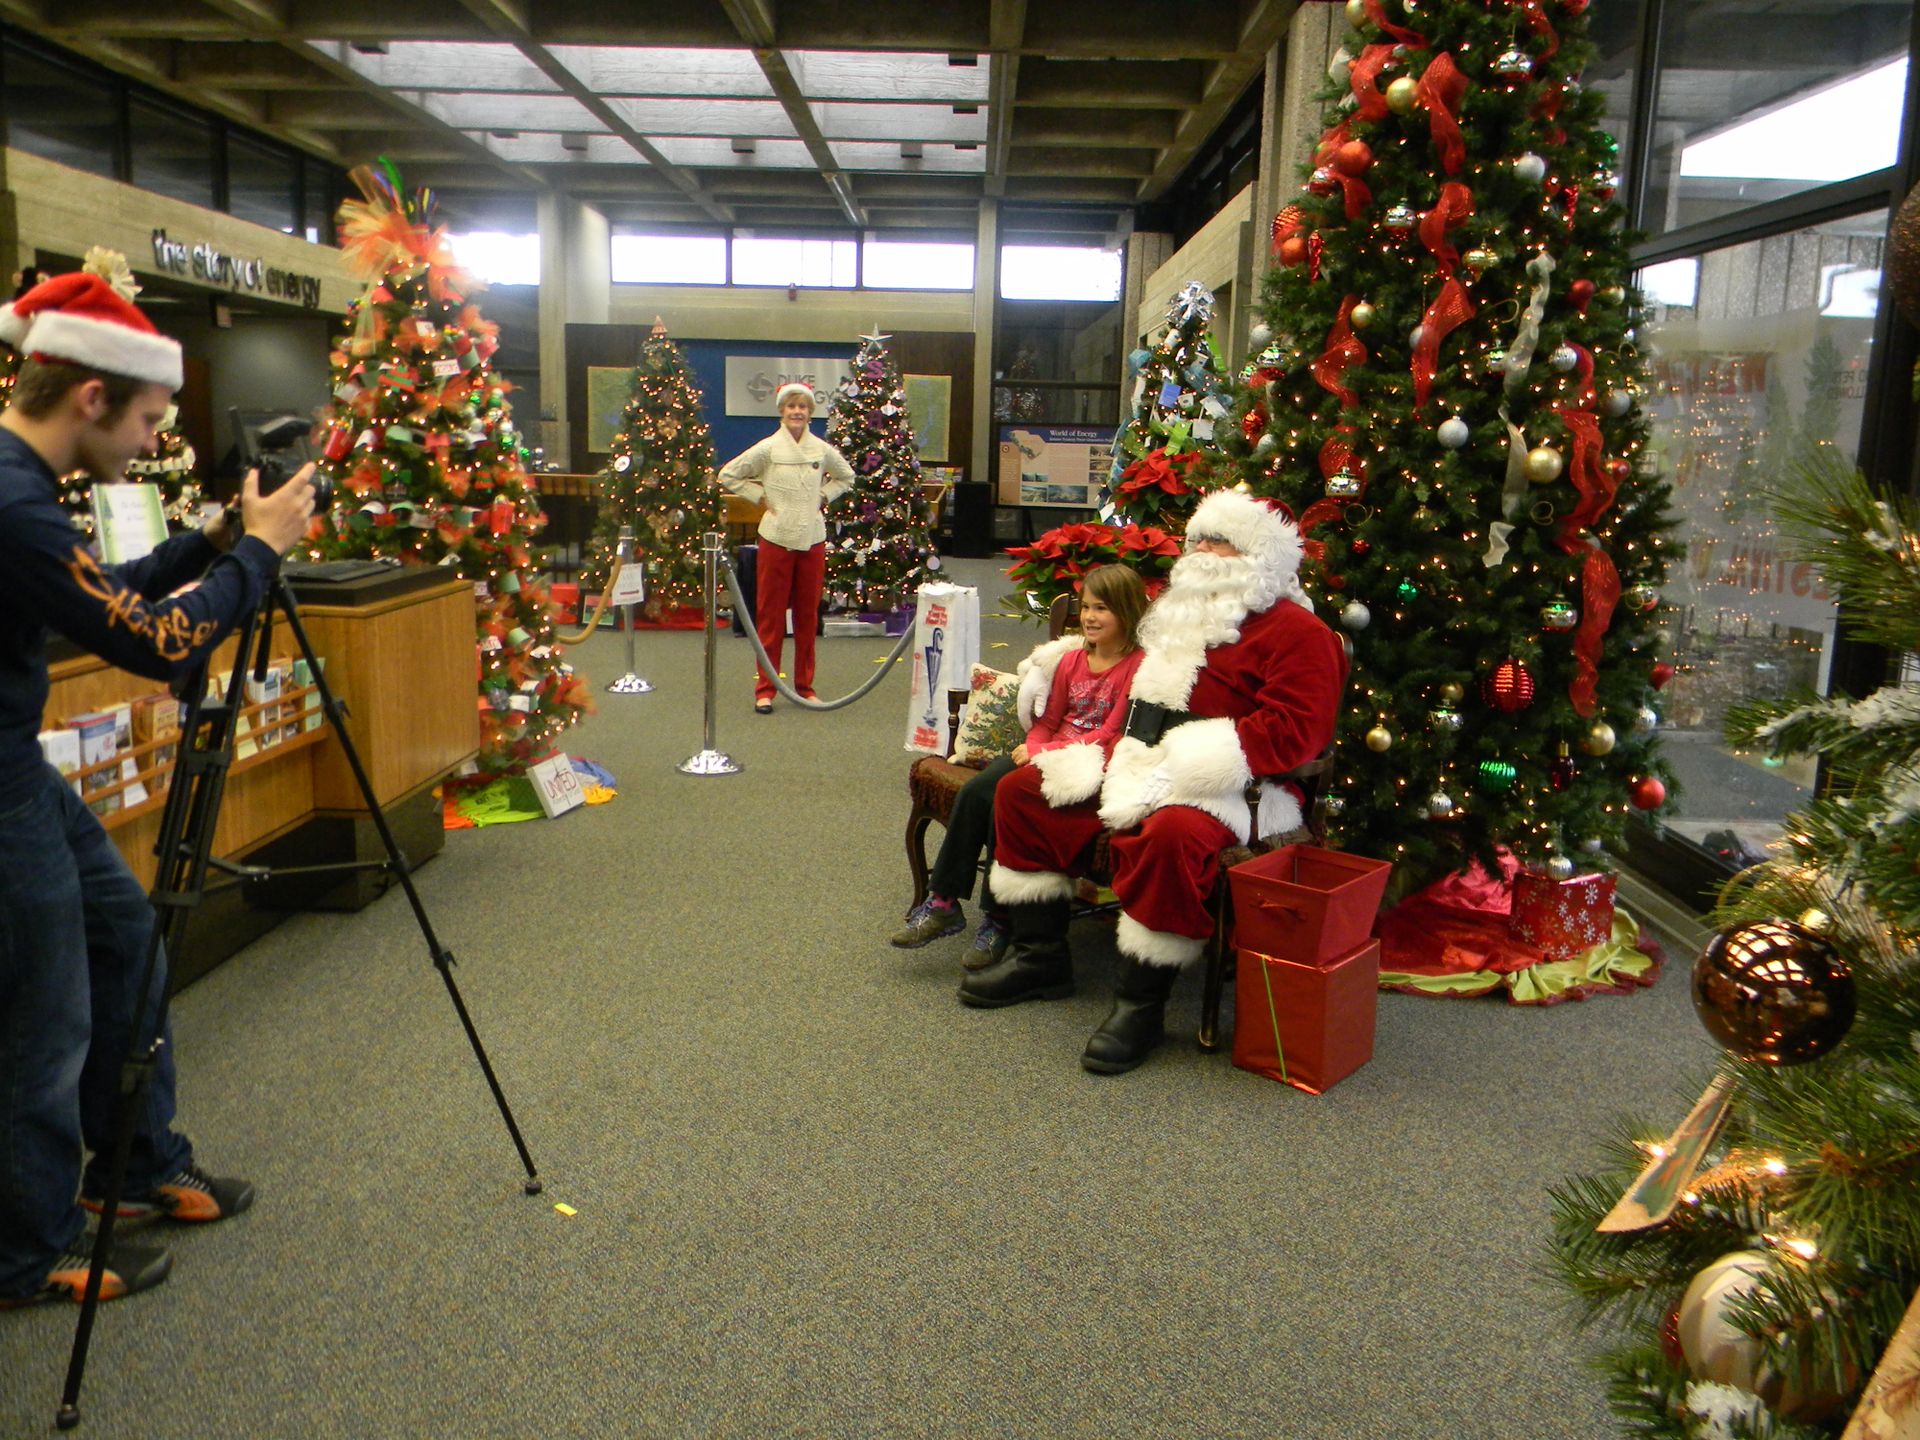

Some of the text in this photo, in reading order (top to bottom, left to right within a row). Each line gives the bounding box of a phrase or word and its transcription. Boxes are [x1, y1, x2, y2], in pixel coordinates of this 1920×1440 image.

[153, 229, 321, 309] the story of energy
[777, 374, 816, 388] DUKE
[1050, 430, 1097, 439] World of Energy
